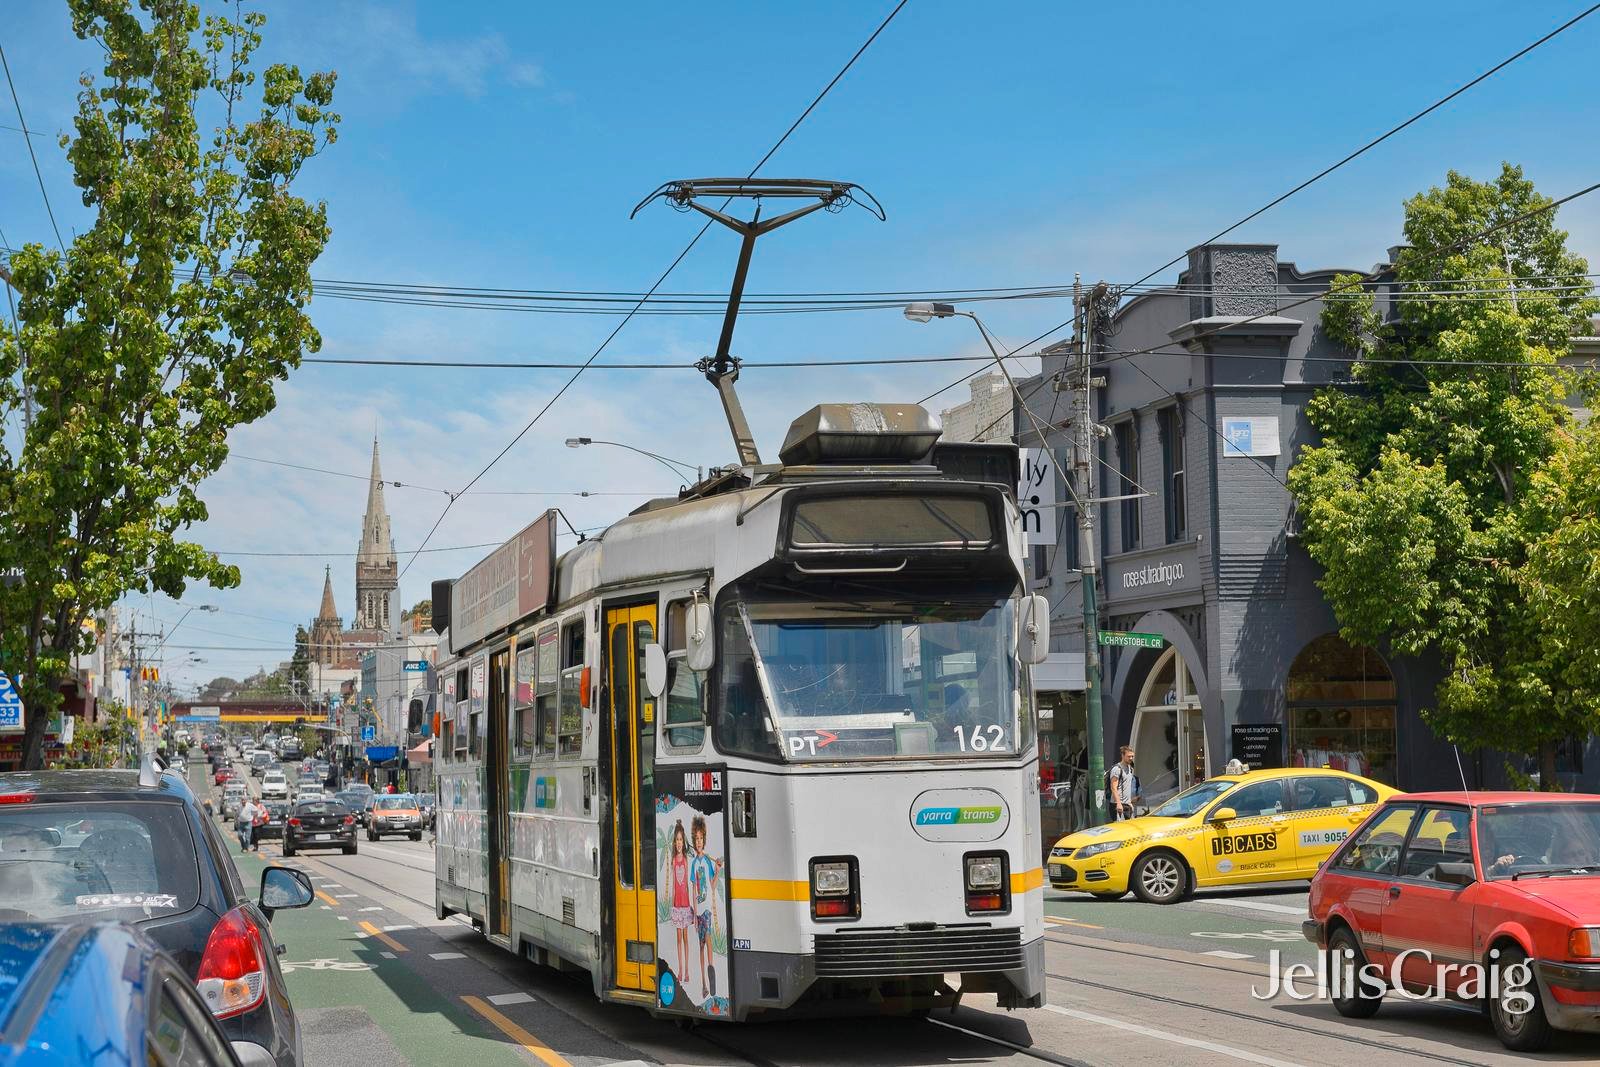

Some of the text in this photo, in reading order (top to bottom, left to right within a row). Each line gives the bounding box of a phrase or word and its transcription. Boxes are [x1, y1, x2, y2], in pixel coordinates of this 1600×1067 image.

[1123, 571, 1139, 588] rose
[1148, 561, 1172, 586] trading
[1172, 563, 1185, 580] co.
[1104, 636, 1149, 647] CHRYSTOBEL
[1151, 639, 1161, 648] CR
[953, 724, 1006, 752] 162
[922, 810, 995, 823] yarra trams
[1302, 832, 1348, 843] TAXI 9055
[734, 940, 750, 949] APN
